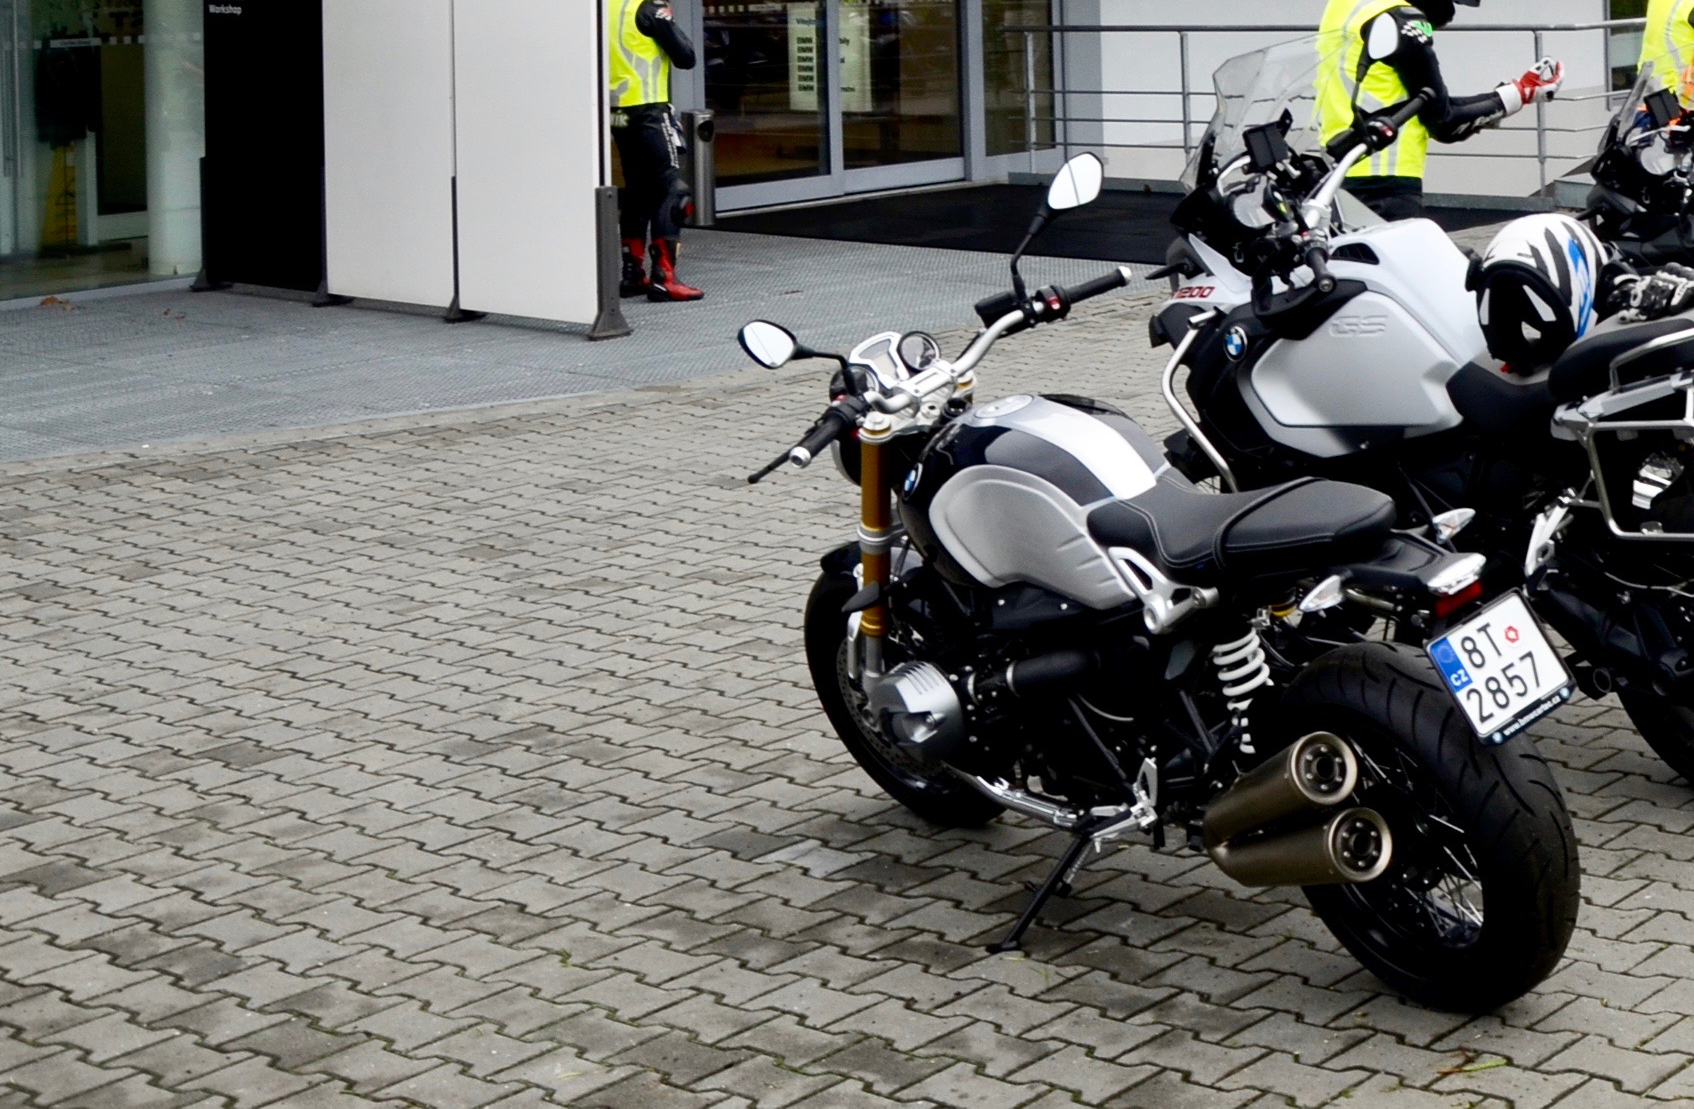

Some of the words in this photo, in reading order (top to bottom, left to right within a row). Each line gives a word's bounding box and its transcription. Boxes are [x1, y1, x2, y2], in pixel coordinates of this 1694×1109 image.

[209, 4, 242, 16] Workshop
[1330, 314, 1389, 338] GS
[1460, 622, 1502, 669] 8T
[1450, 668, 1469, 687] CZ
[1466, 650, 1541, 724] 2857
